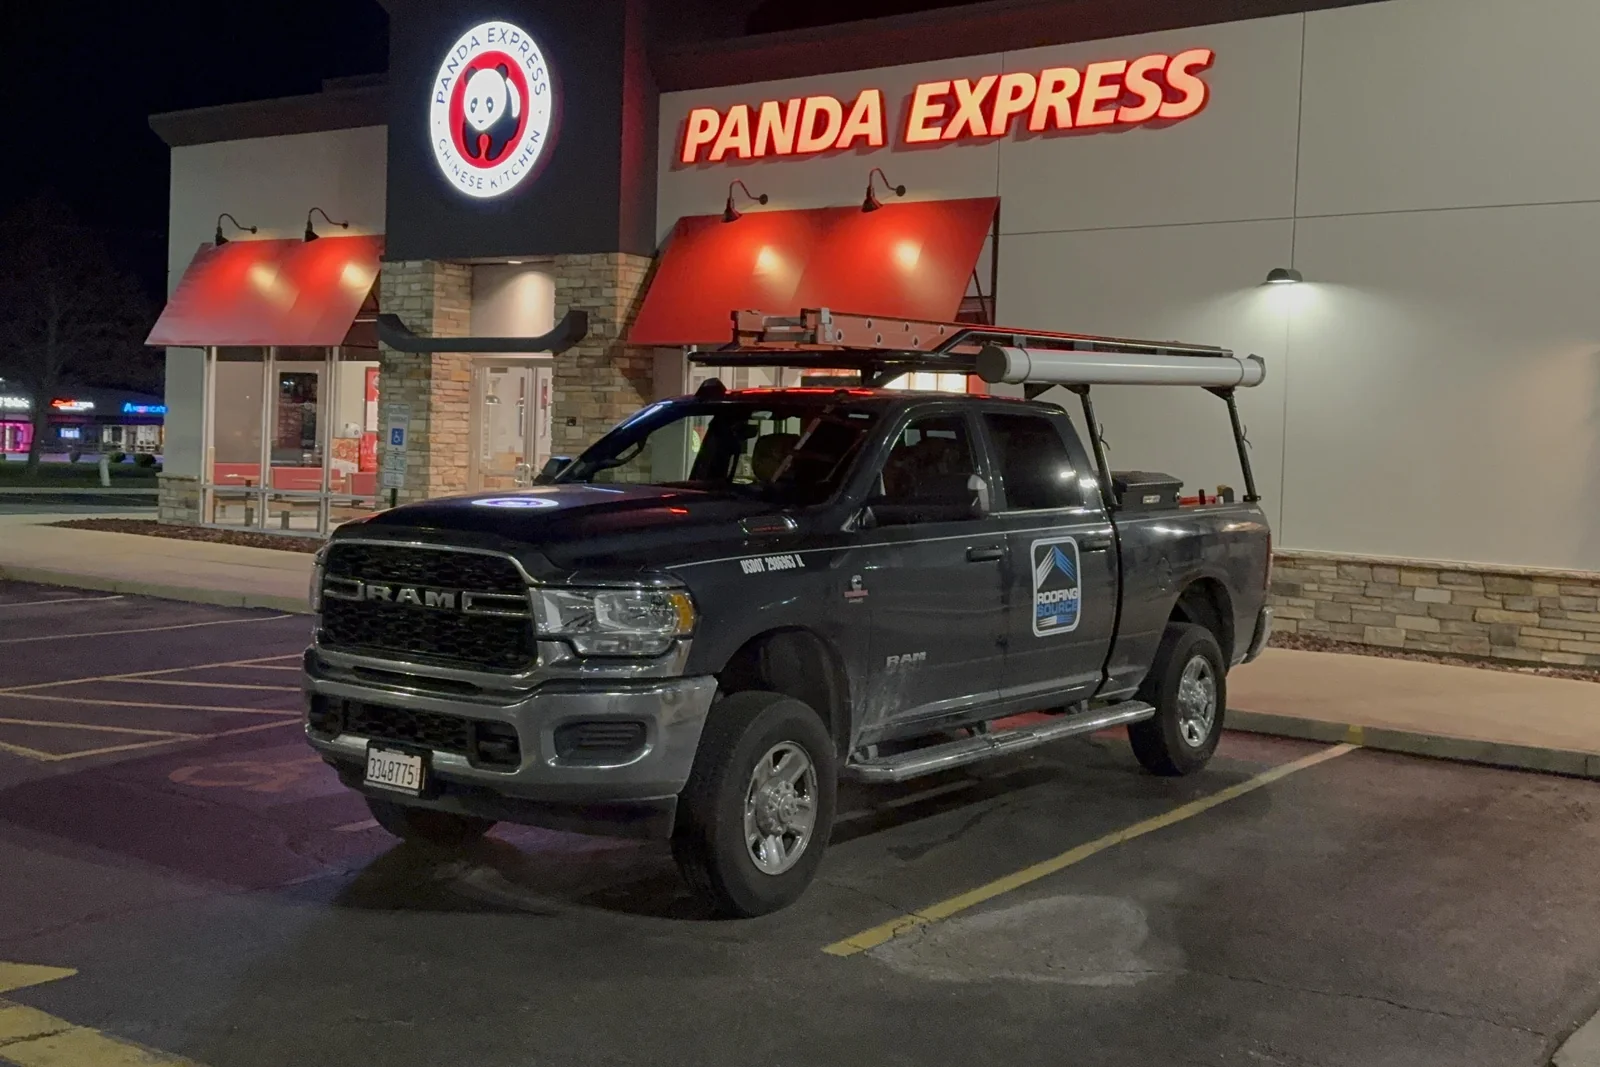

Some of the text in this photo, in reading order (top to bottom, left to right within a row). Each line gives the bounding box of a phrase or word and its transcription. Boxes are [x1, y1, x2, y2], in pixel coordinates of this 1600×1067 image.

[436, 27, 547, 104] PANDA EXPRESS
[681, 48, 1215, 163] PANDA EXPRESS
[438, 130, 541, 190] CHINESE KITCHEN
[740, 557, 767, 575] USDOT
[366, 584, 455, 608] RAM
[1037, 587, 1079, 604] ROOFING
[1037, 600, 1079, 617] SOURCE
[886, 651, 927, 667] RAM
[369, 757, 416, 786] 3348775
